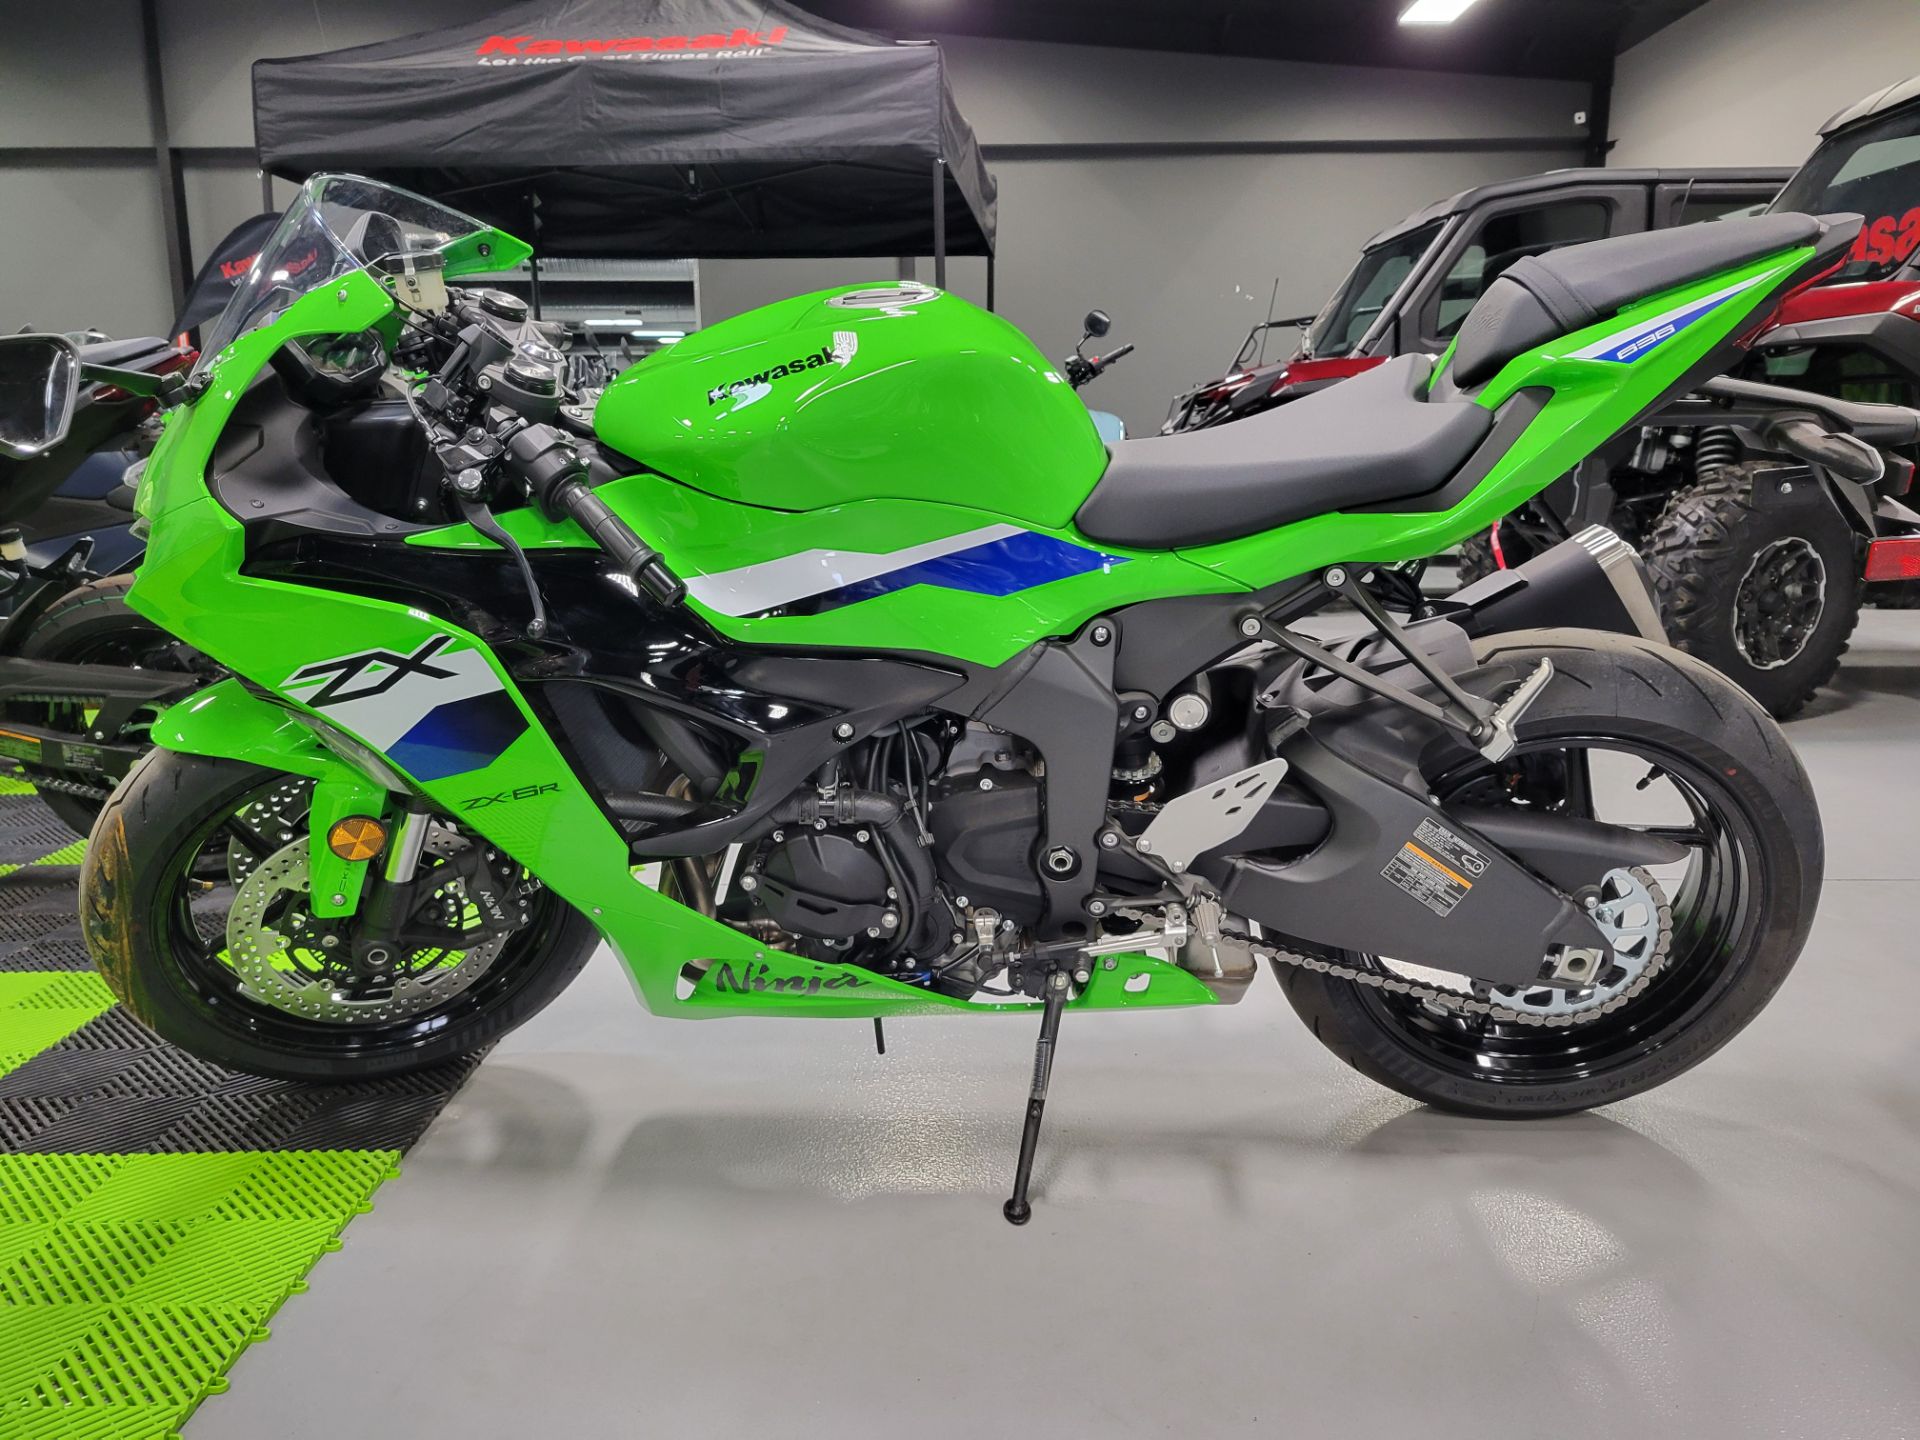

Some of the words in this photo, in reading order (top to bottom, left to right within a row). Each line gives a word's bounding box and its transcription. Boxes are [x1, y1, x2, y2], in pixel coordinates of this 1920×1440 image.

[476, 26, 788, 55] Kawasaki
[1616, 323, 1677, 360] 636
[290, 634, 460, 709] ZX
[459, 782, 563, 812] ZX-6R
[714, 961, 873, 998] Ninja
